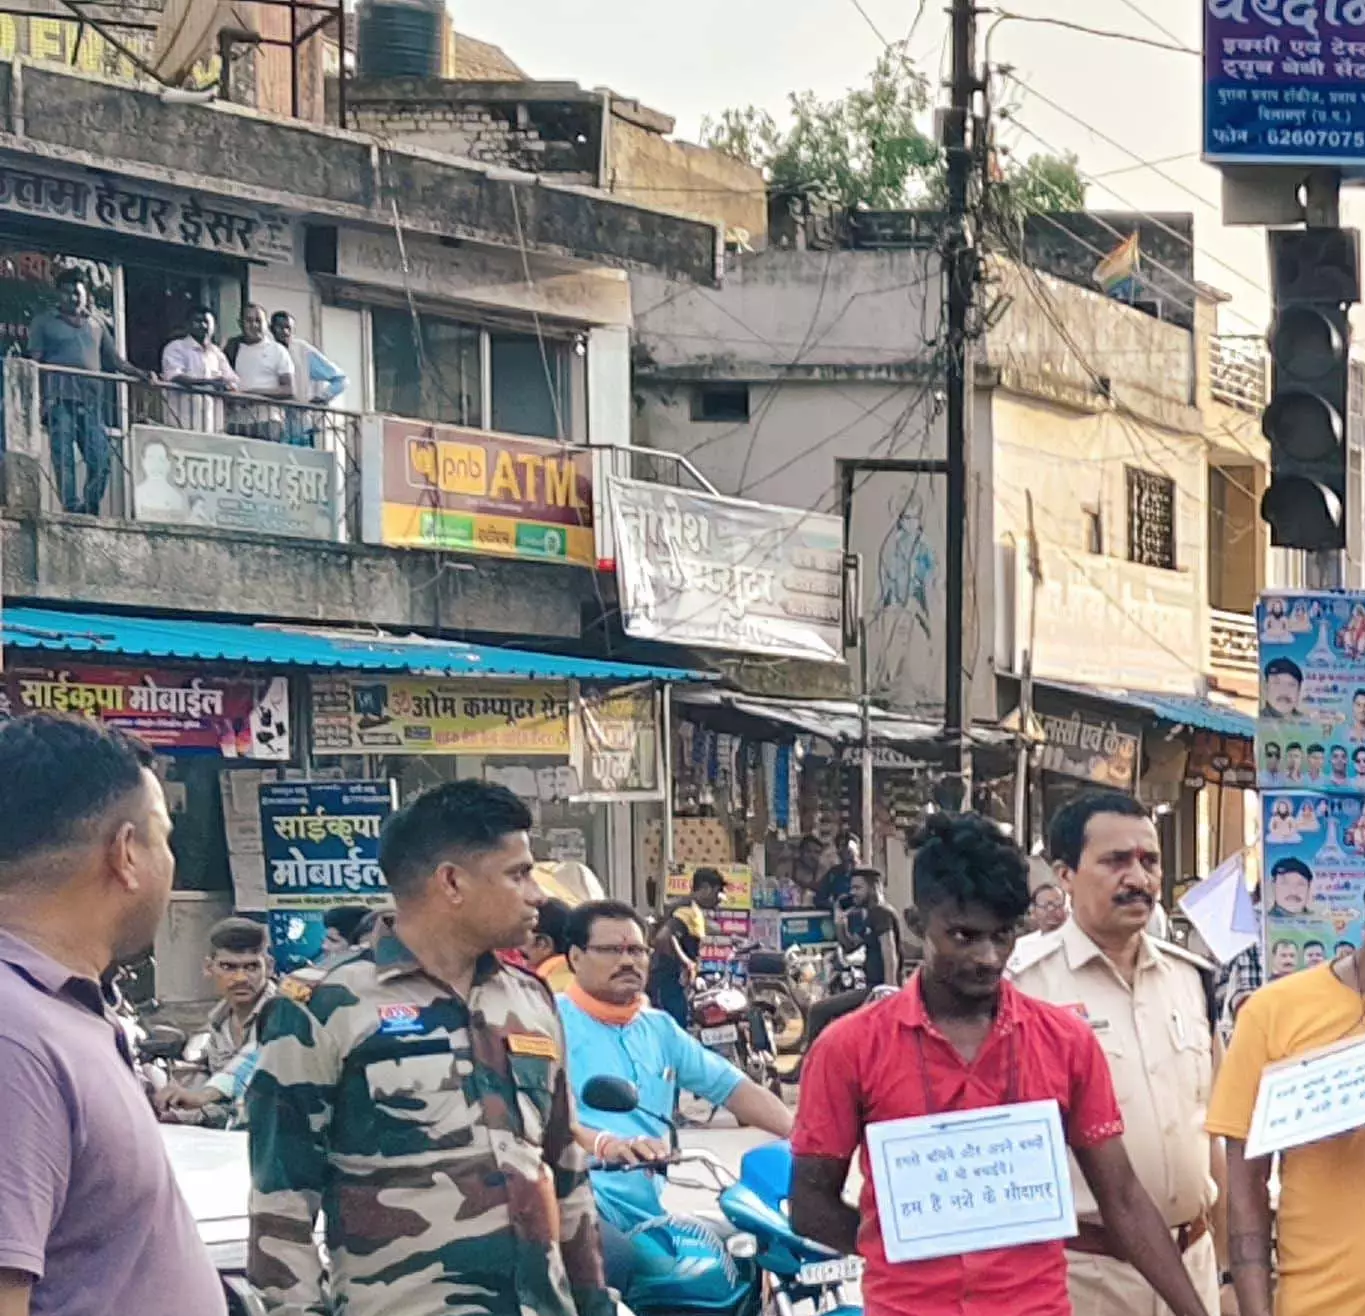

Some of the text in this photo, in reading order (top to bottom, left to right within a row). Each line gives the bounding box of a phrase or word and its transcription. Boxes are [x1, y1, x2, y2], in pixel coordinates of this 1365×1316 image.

[0, 168, 88, 220] त्तम
[95, 183, 171, 234] हेयर
[173, 449, 231, 491] उत्तम
[238, 446, 282, 498] हेयर
[443, 449, 580, 508] pnb ATM
[129, 675, 224, 717] मोबाईल
[412, 688, 456, 718] ओम
